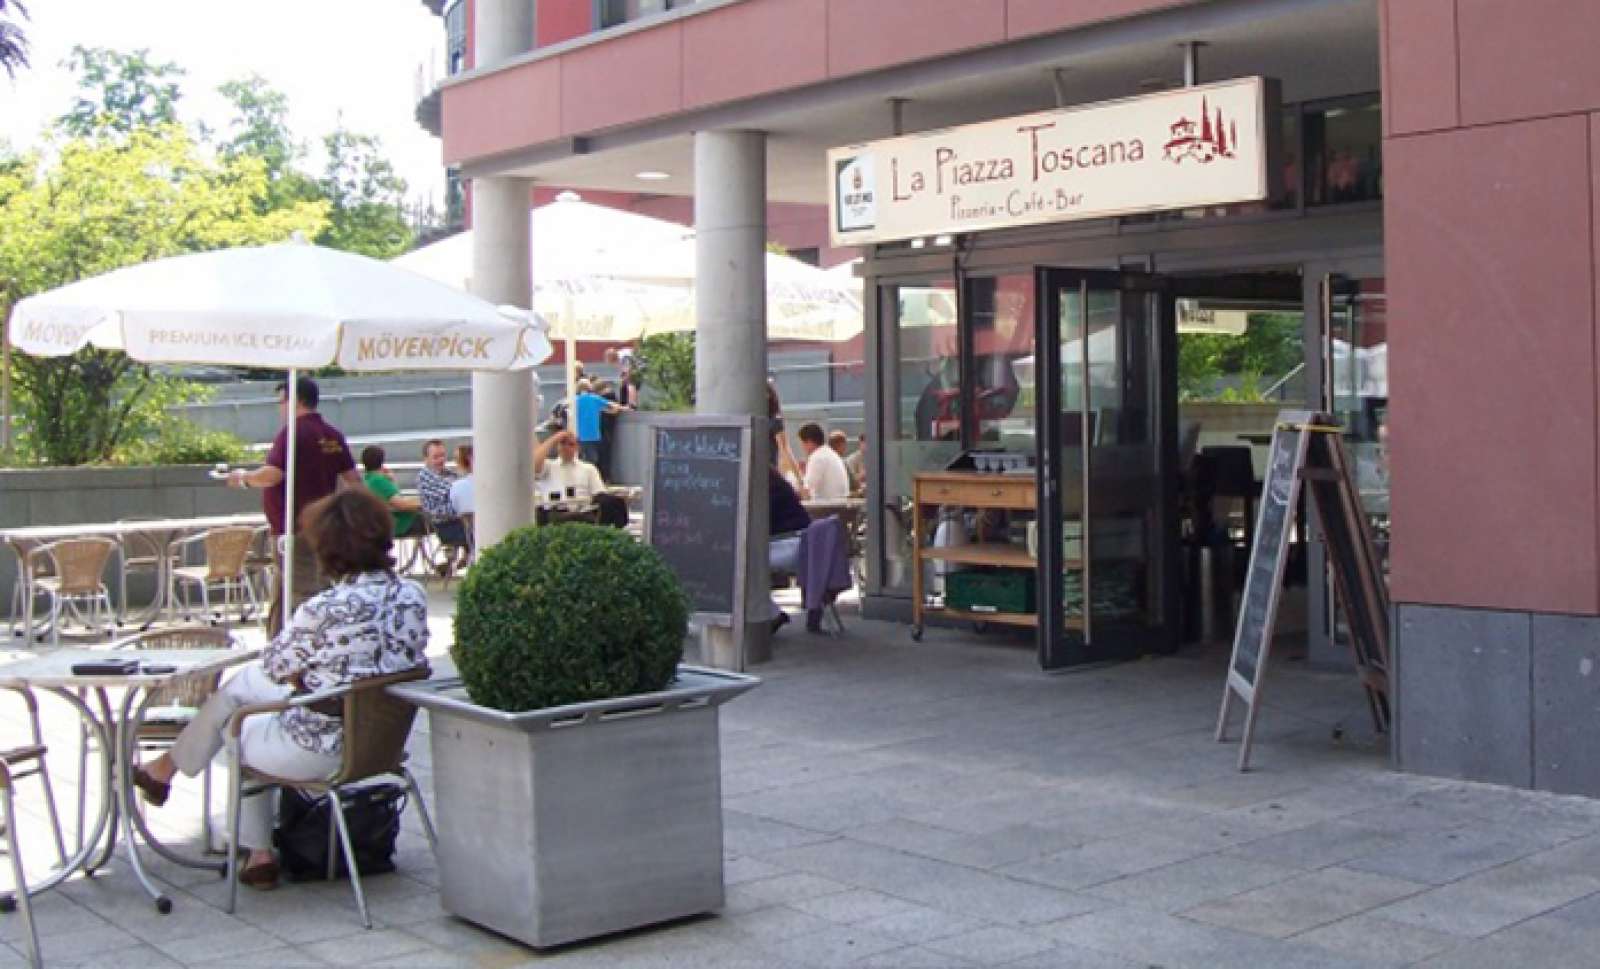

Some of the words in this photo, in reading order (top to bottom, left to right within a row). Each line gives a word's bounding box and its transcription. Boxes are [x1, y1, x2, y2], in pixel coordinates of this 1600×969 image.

[893, 156, 925, 201] La
[936, 147, 1015, 194] Piazza
[1017, 121, 1145, 182] Toscana
[1055, 187, 1084, 210] Bar
[148, 328, 230, 347] PREMIUM
[232, 331, 257, 350] ICE
